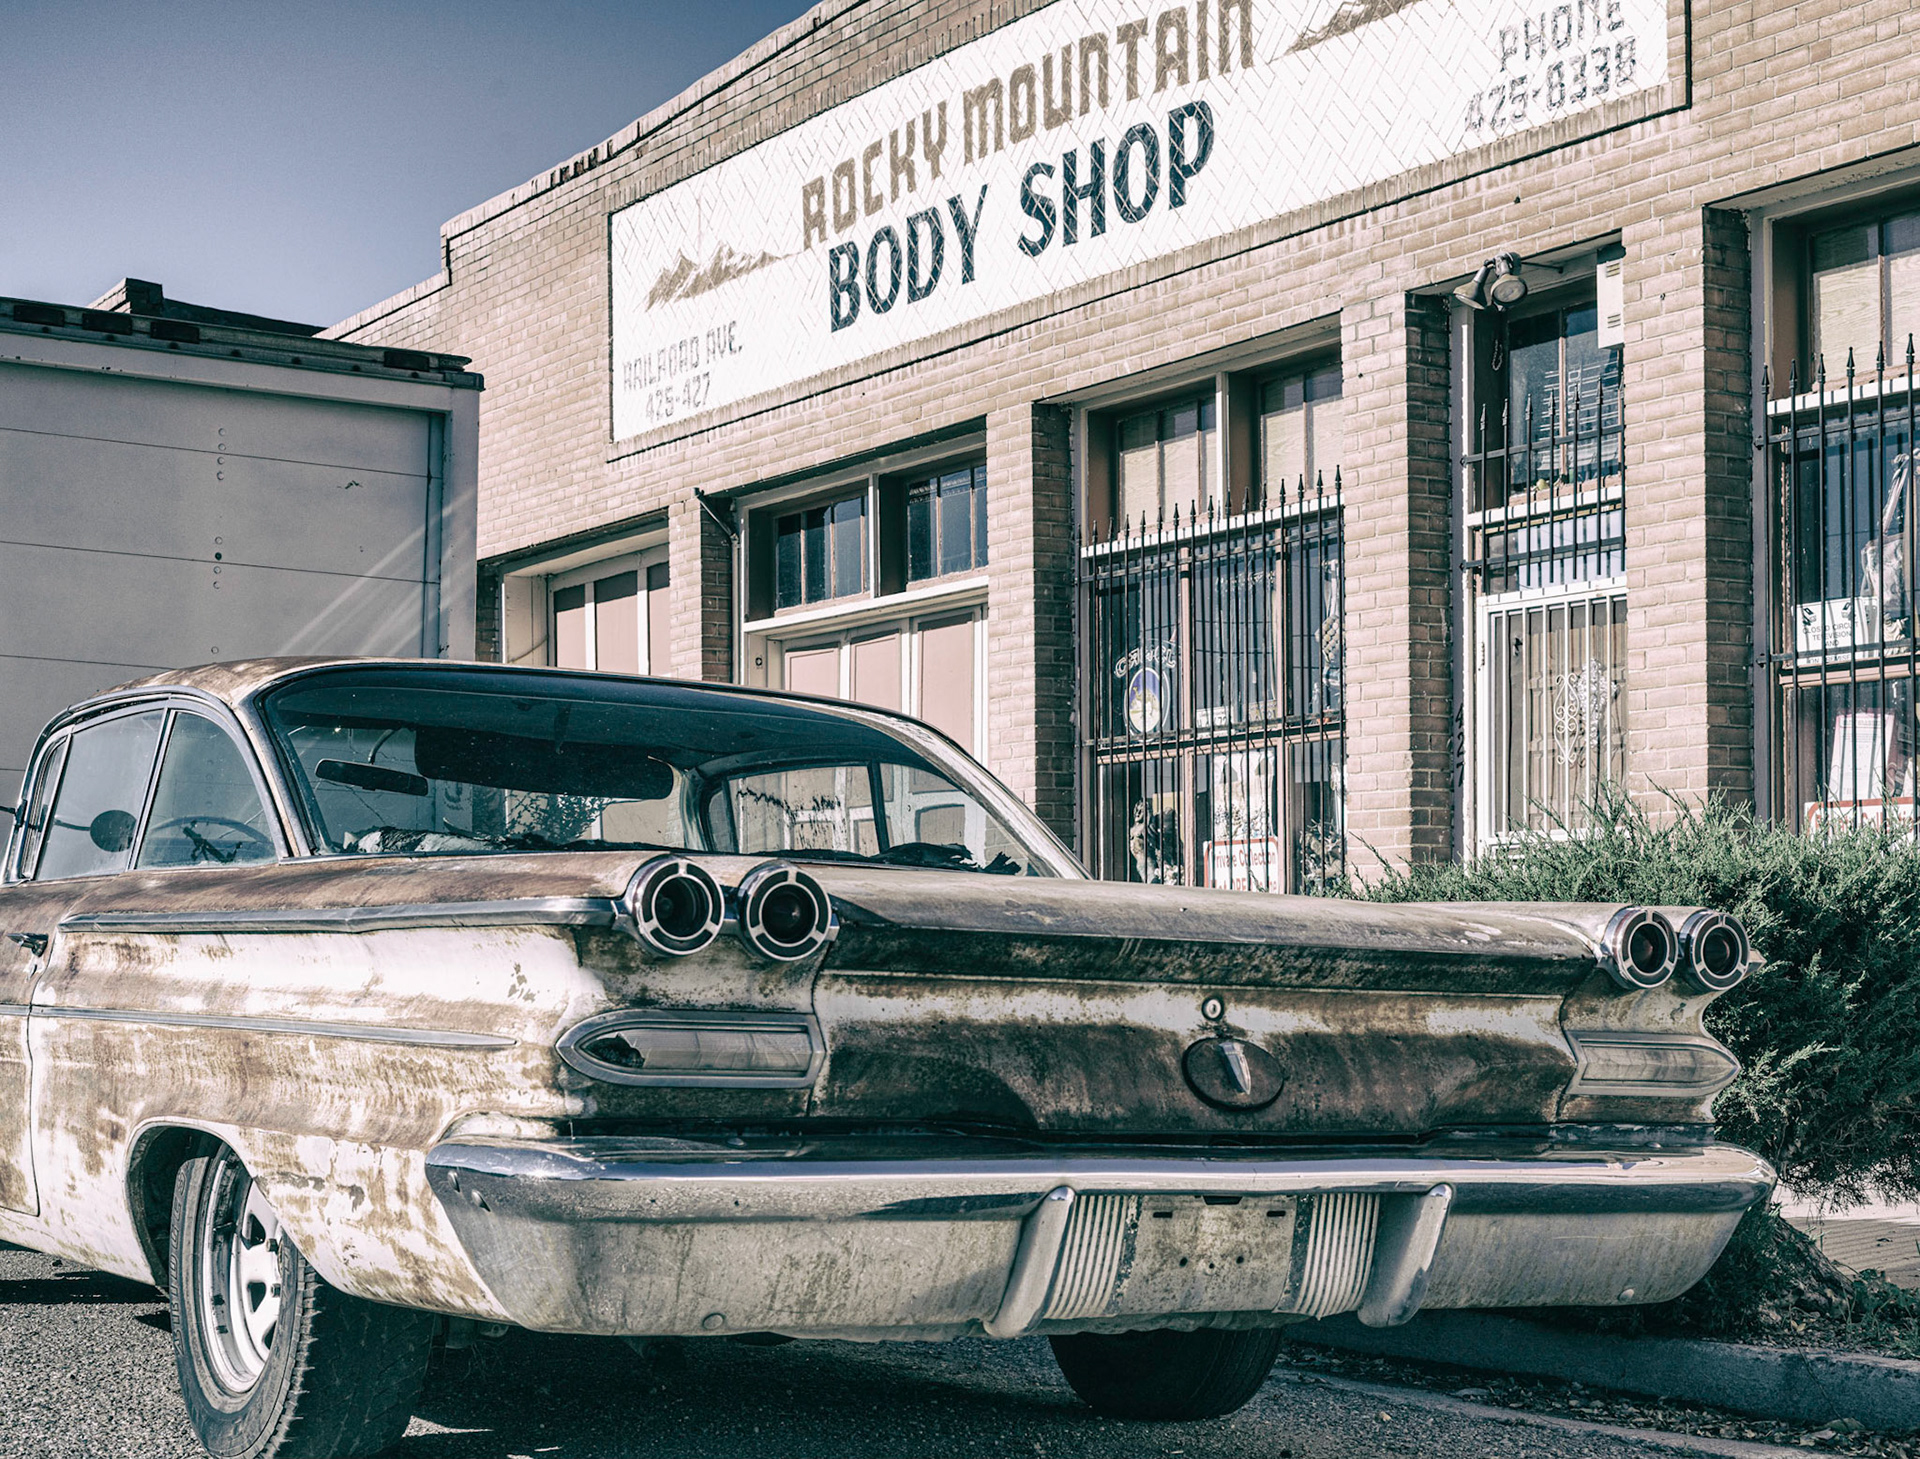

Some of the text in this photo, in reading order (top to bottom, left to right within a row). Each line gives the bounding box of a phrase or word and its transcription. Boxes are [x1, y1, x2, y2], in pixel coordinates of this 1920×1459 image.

[1498, 0, 1626, 73] PHONE
[802, 0, 1254, 250] ROCKY MOUNTAIN
[829, 100, 1215, 333] BODY SHOP
[623, 320, 743, 393] RAILROAD AVE.
[645, 371, 711, 422] 425-427
[1802, 621, 1859, 635] CLOSD CIRCUT
[1812, 630, 1852, 641] TEEVISION
[1455, 702, 1466, 788] 427
[1210, 848, 1277, 868] rivae Colecton
